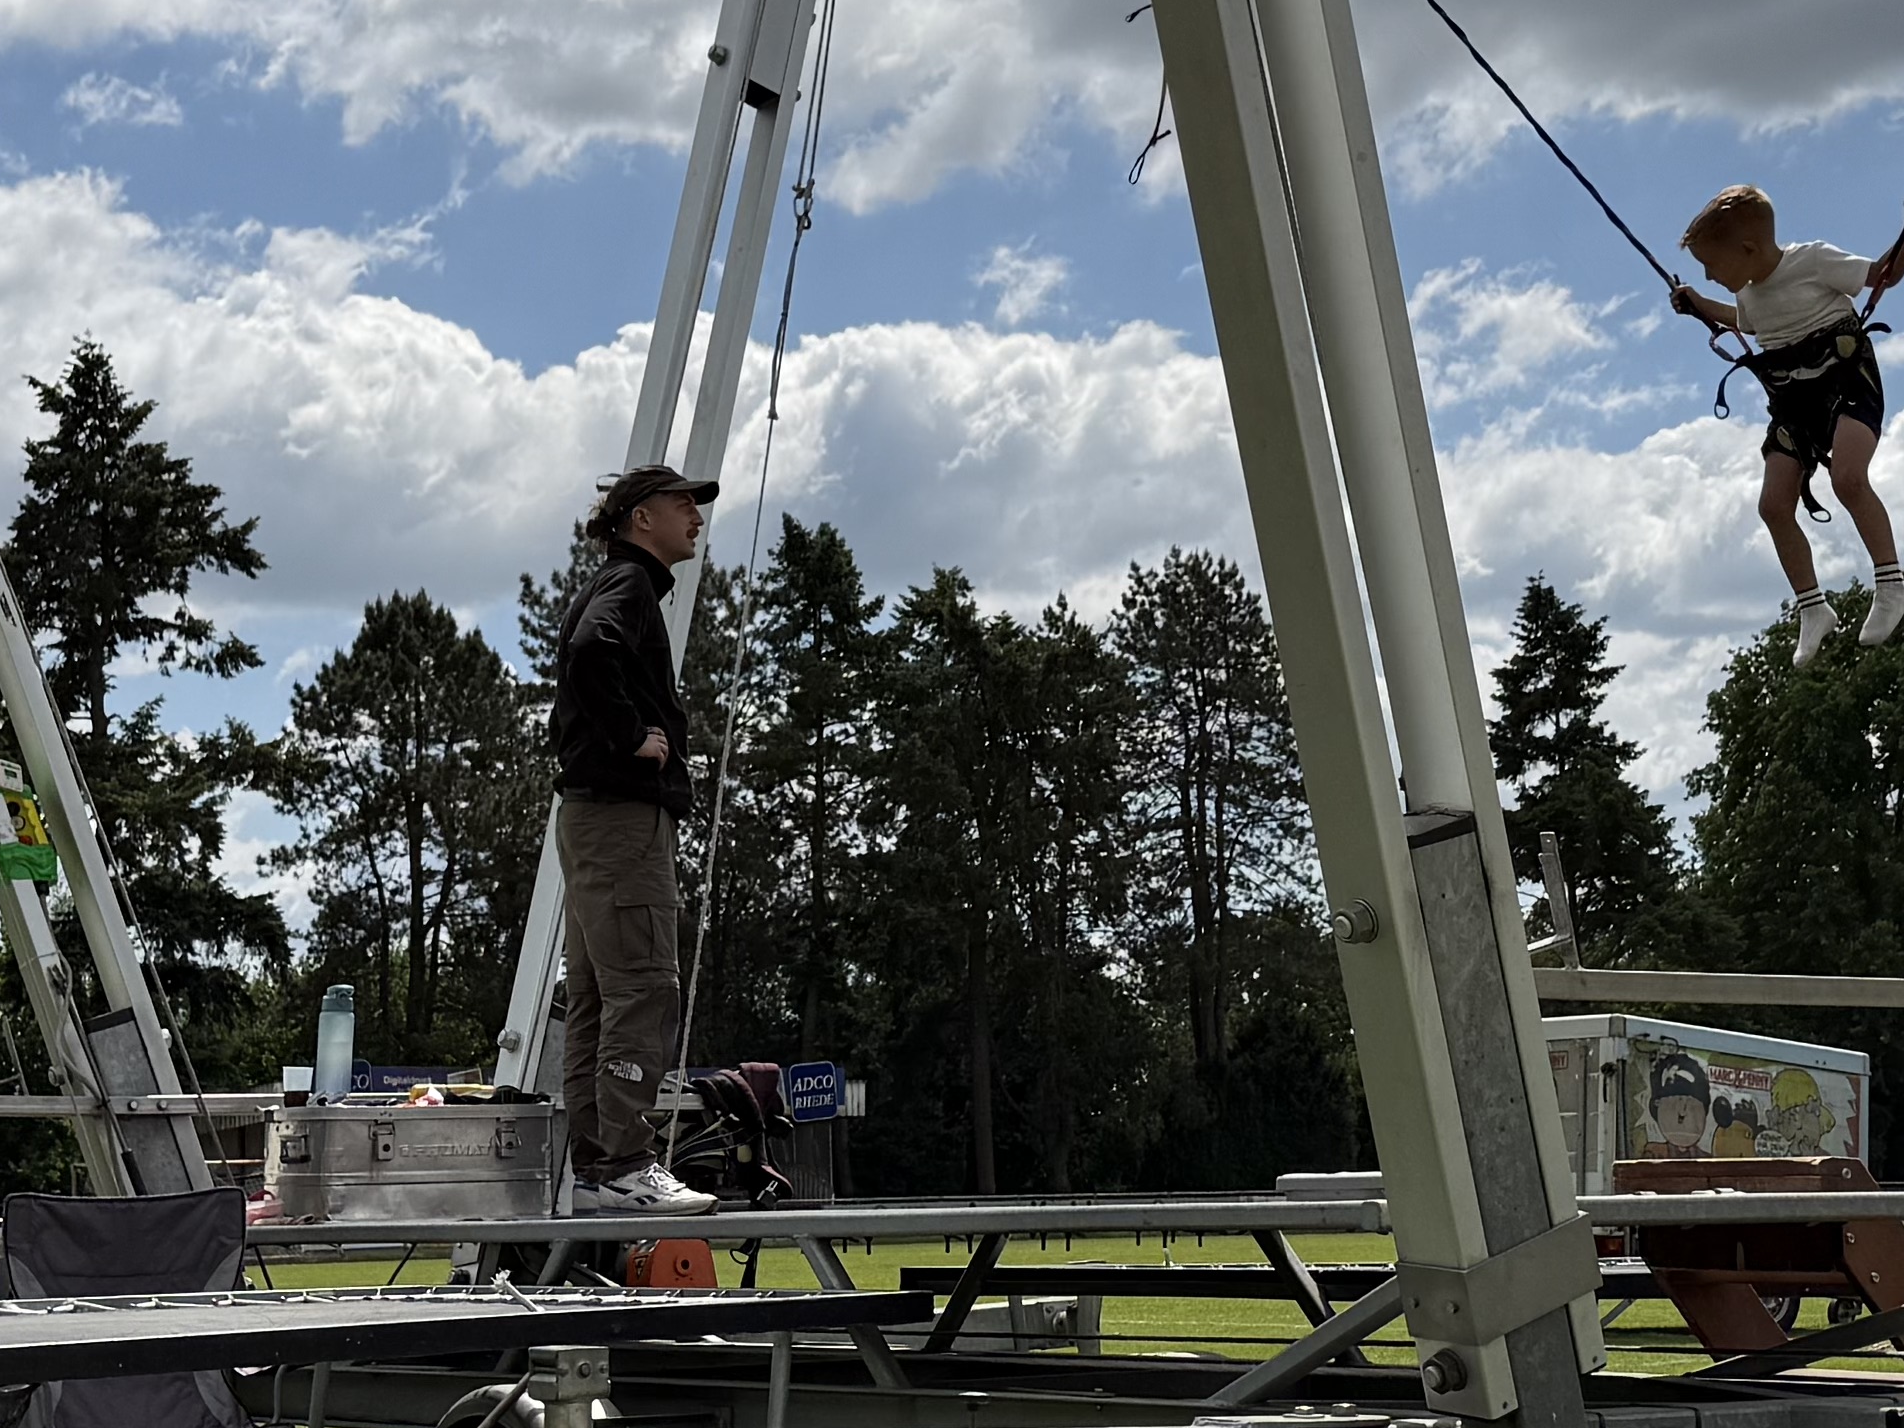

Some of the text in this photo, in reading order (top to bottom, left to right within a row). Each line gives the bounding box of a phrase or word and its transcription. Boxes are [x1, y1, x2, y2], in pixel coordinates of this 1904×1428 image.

[793, 1074, 834, 1093] ADCO
[1743, 1071, 1769, 1089] PENNY
[794, 1093, 834, 1109] RHEDE
